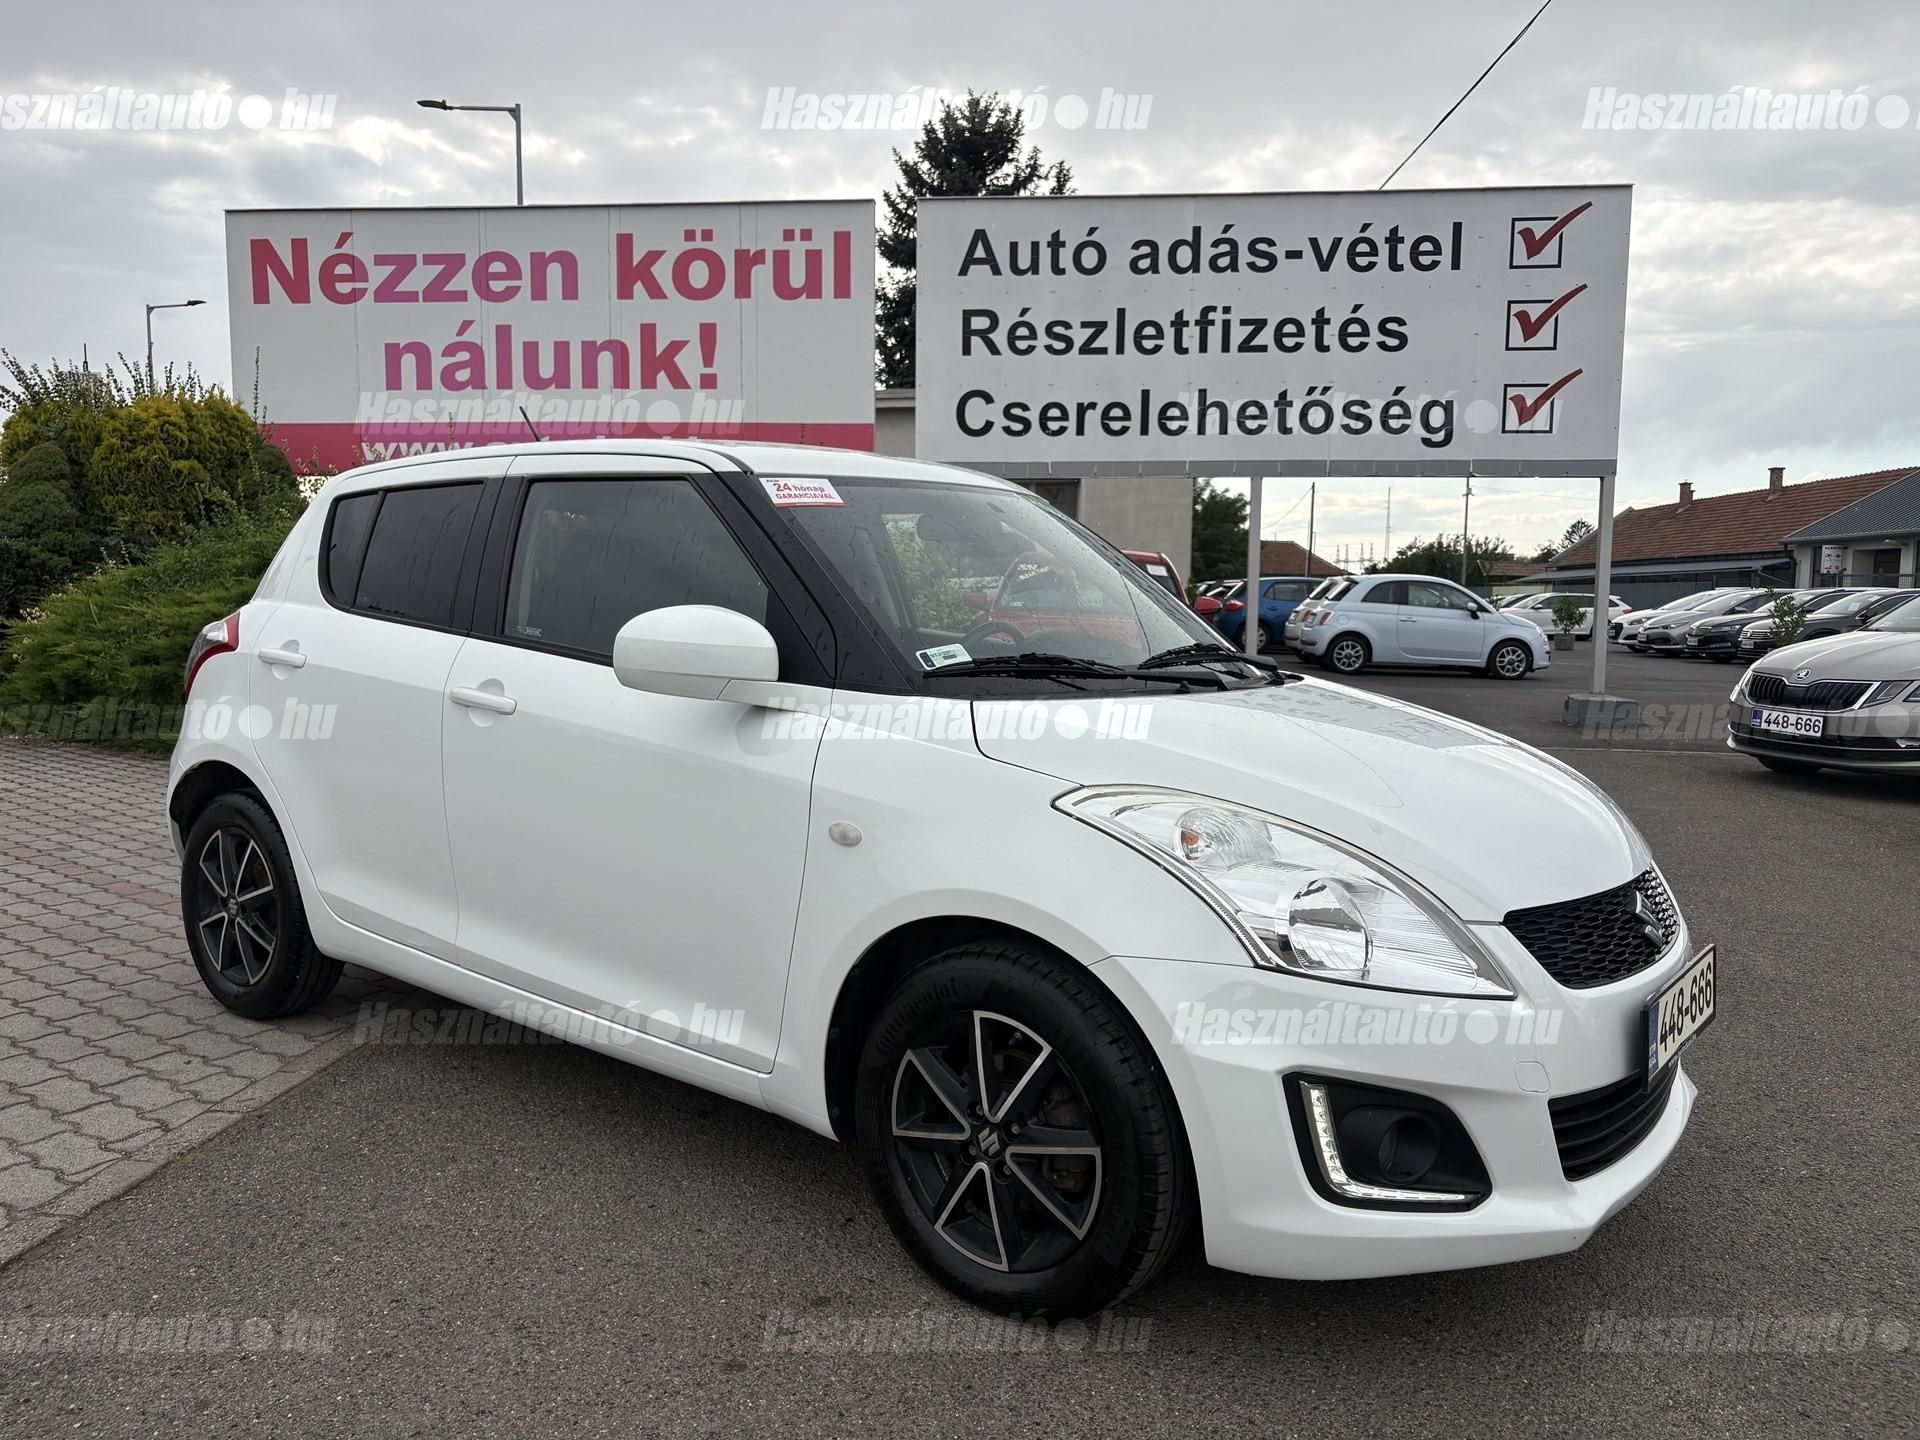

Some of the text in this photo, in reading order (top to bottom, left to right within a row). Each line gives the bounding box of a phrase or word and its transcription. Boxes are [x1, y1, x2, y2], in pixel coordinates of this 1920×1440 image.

[250, 228, 852, 305] Nézzen körül
[957, 220, 1463, 277] Autó adás-vétel
[385, 319, 718, 392] nálunk!
[961, 304, 1409, 357] Részletfizetés
[955, 385, 1456, 448] Cserelehetőség
[773, 482, 791, 492] 24
[1764, 713, 1821, 733] 448-666
[1660, 961, 1712, 1052] 448-666
